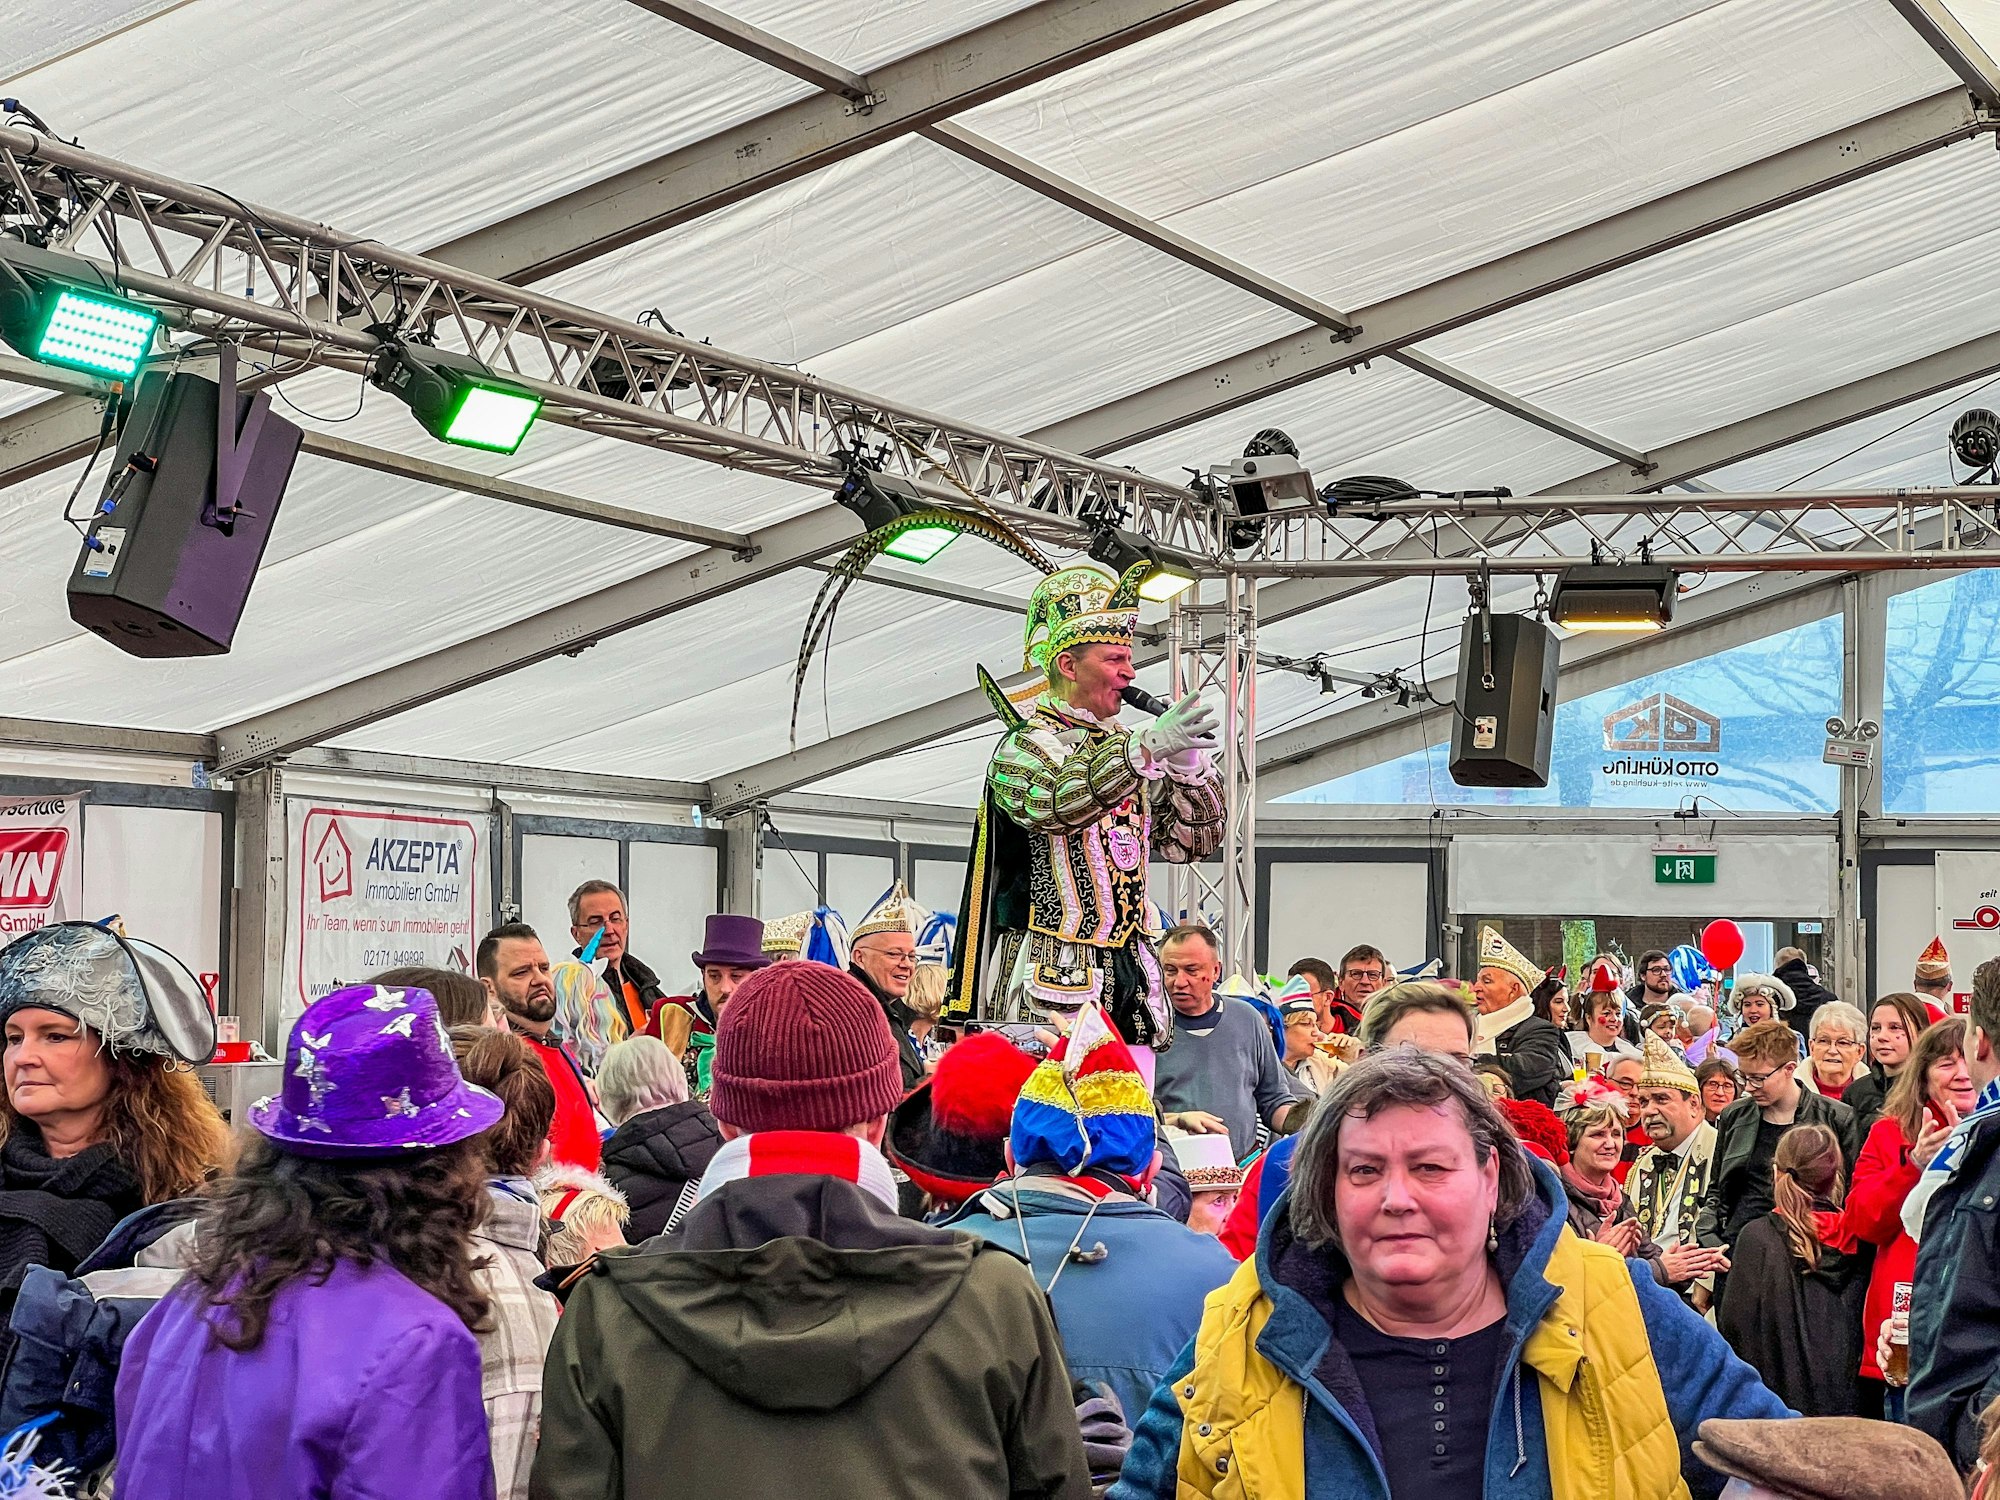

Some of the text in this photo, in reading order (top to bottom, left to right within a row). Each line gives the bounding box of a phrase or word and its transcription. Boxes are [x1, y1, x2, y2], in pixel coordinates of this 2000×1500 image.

[365, 879, 460, 903] Immobilien GmbH
[1979, 888, 1998, 899] seit
[0, 913, 45, 932] GmbH
[307, 913, 320, 931] Ihr
[323, 913, 350, 933] Team,
[387, 918, 401, 933] um
[403, 917, 449, 934] Immobilien
[450, 919, 470, 938] geht!
[363, 950, 425, 967] 02171 949898
